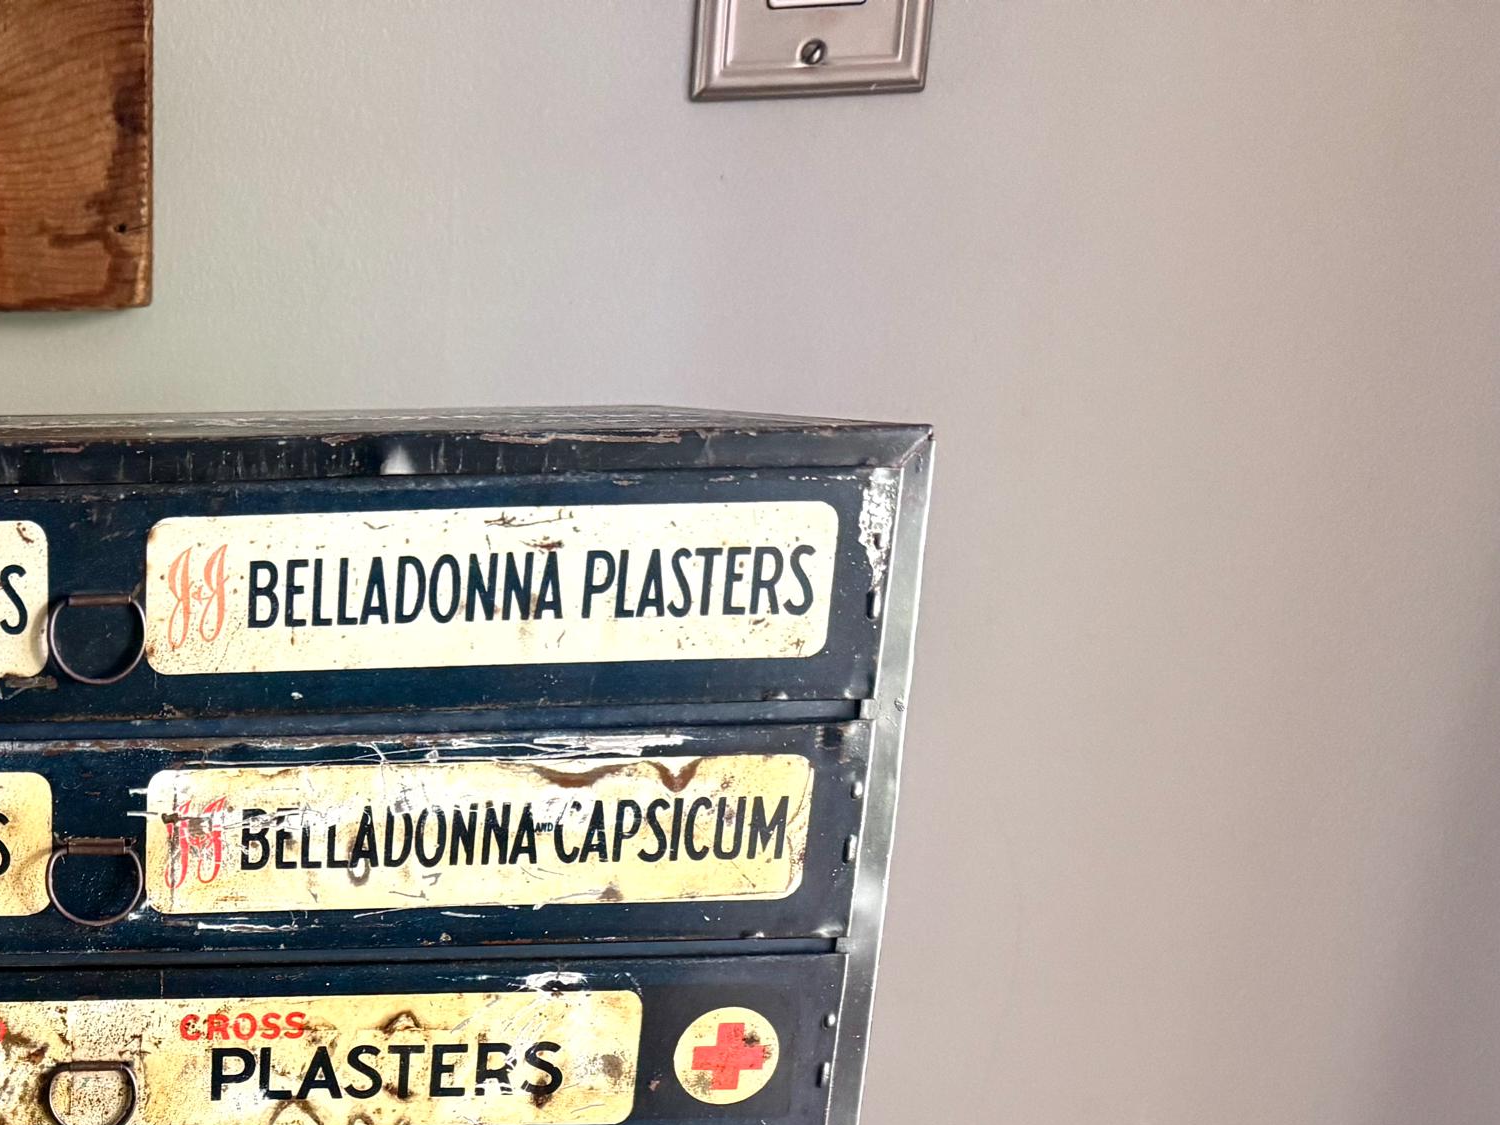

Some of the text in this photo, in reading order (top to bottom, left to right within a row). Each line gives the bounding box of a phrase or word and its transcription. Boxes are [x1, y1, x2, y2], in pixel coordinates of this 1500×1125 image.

[248, 551, 562, 629] BELLADONNA
[581, 545, 815, 619] PLASTERS
[240, 802, 538, 871] BELLADONNA
[534, 822, 554, 834] AND
[553, 795, 790, 864] CAPSICUM
[180, 1011, 306, 1041] CROSS
[211, 1041, 564, 1101] PLASTERS
